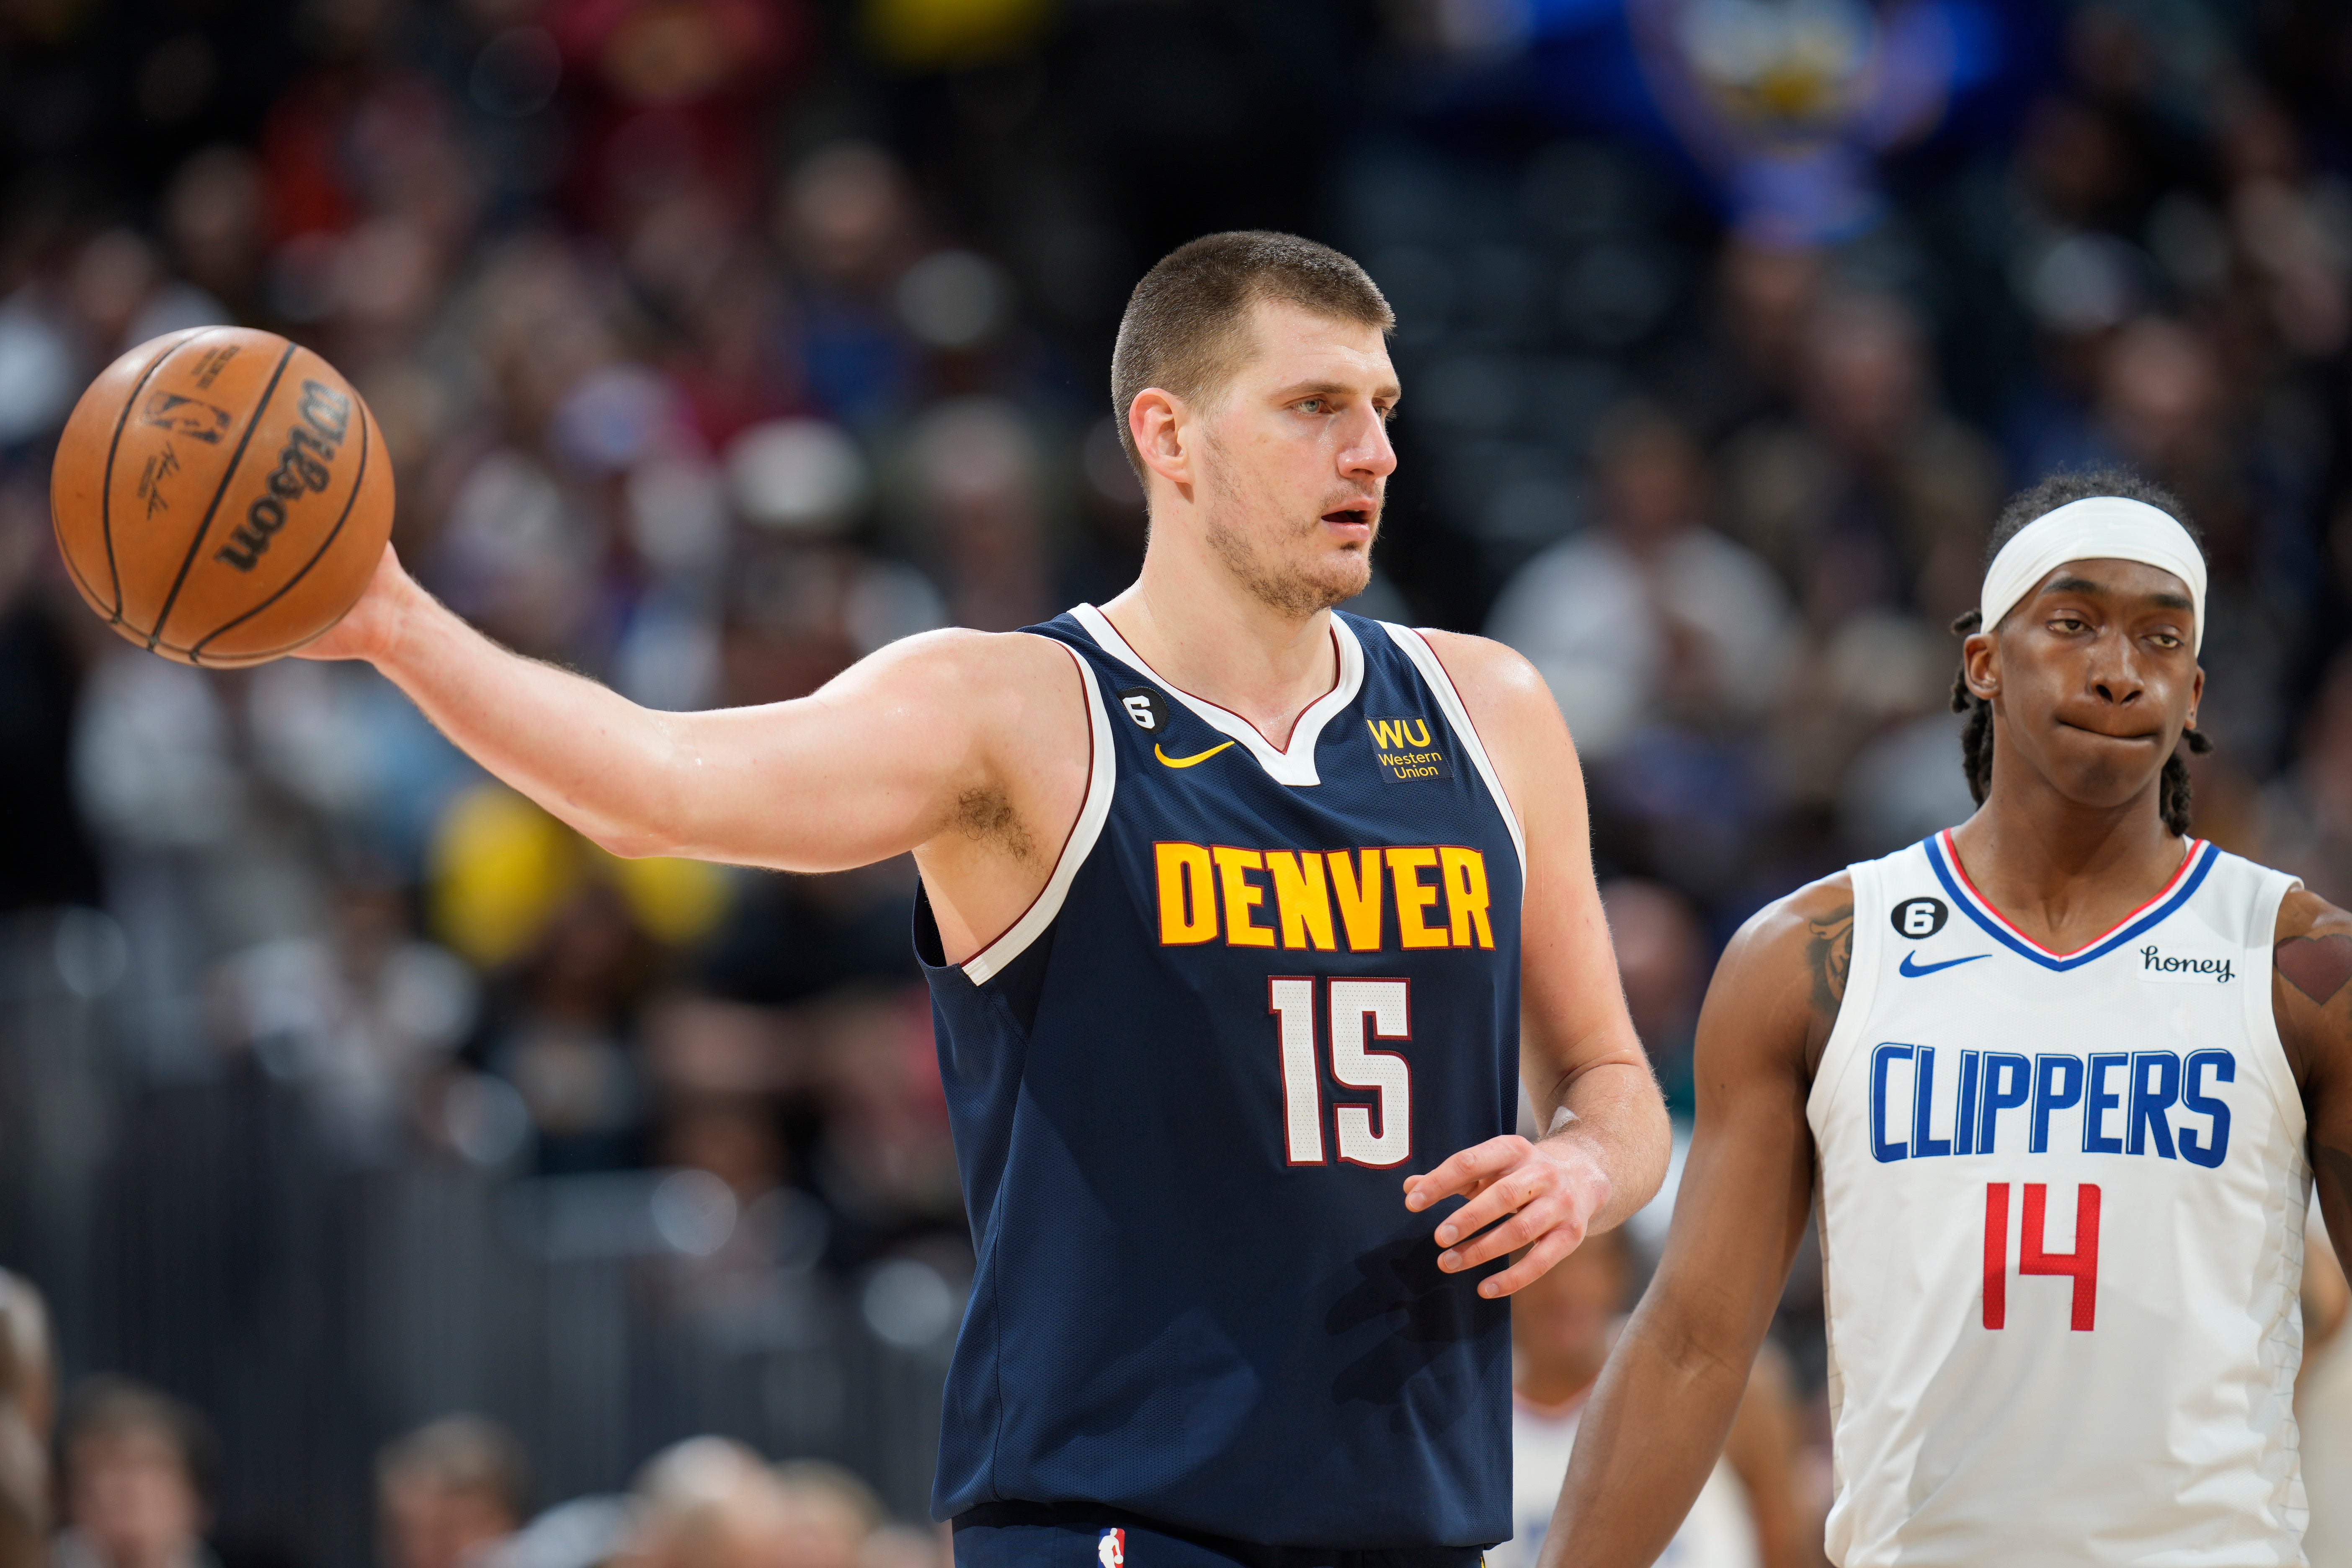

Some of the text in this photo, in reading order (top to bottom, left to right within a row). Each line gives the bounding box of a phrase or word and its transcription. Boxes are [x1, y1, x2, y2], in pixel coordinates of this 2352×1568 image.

[214, 379, 350, 573] Wilson
[1122, 696, 1155, 729] 6
[1367, 719, 1431, 749] WU
[1378, 753, 1442, 766] Western
[1394, 765, 1439, 779] Union
[1153, 840, 1496, 952] DENVER
[1903, 902, 1935, 934] 6
[2140, 945, 2236, 983] honey
[1268, 975, 1411, 1169] 15
[1870, 1042, 2236, 1168] CLIPPERS
[1983, 1182, 2102, 1331] 14
